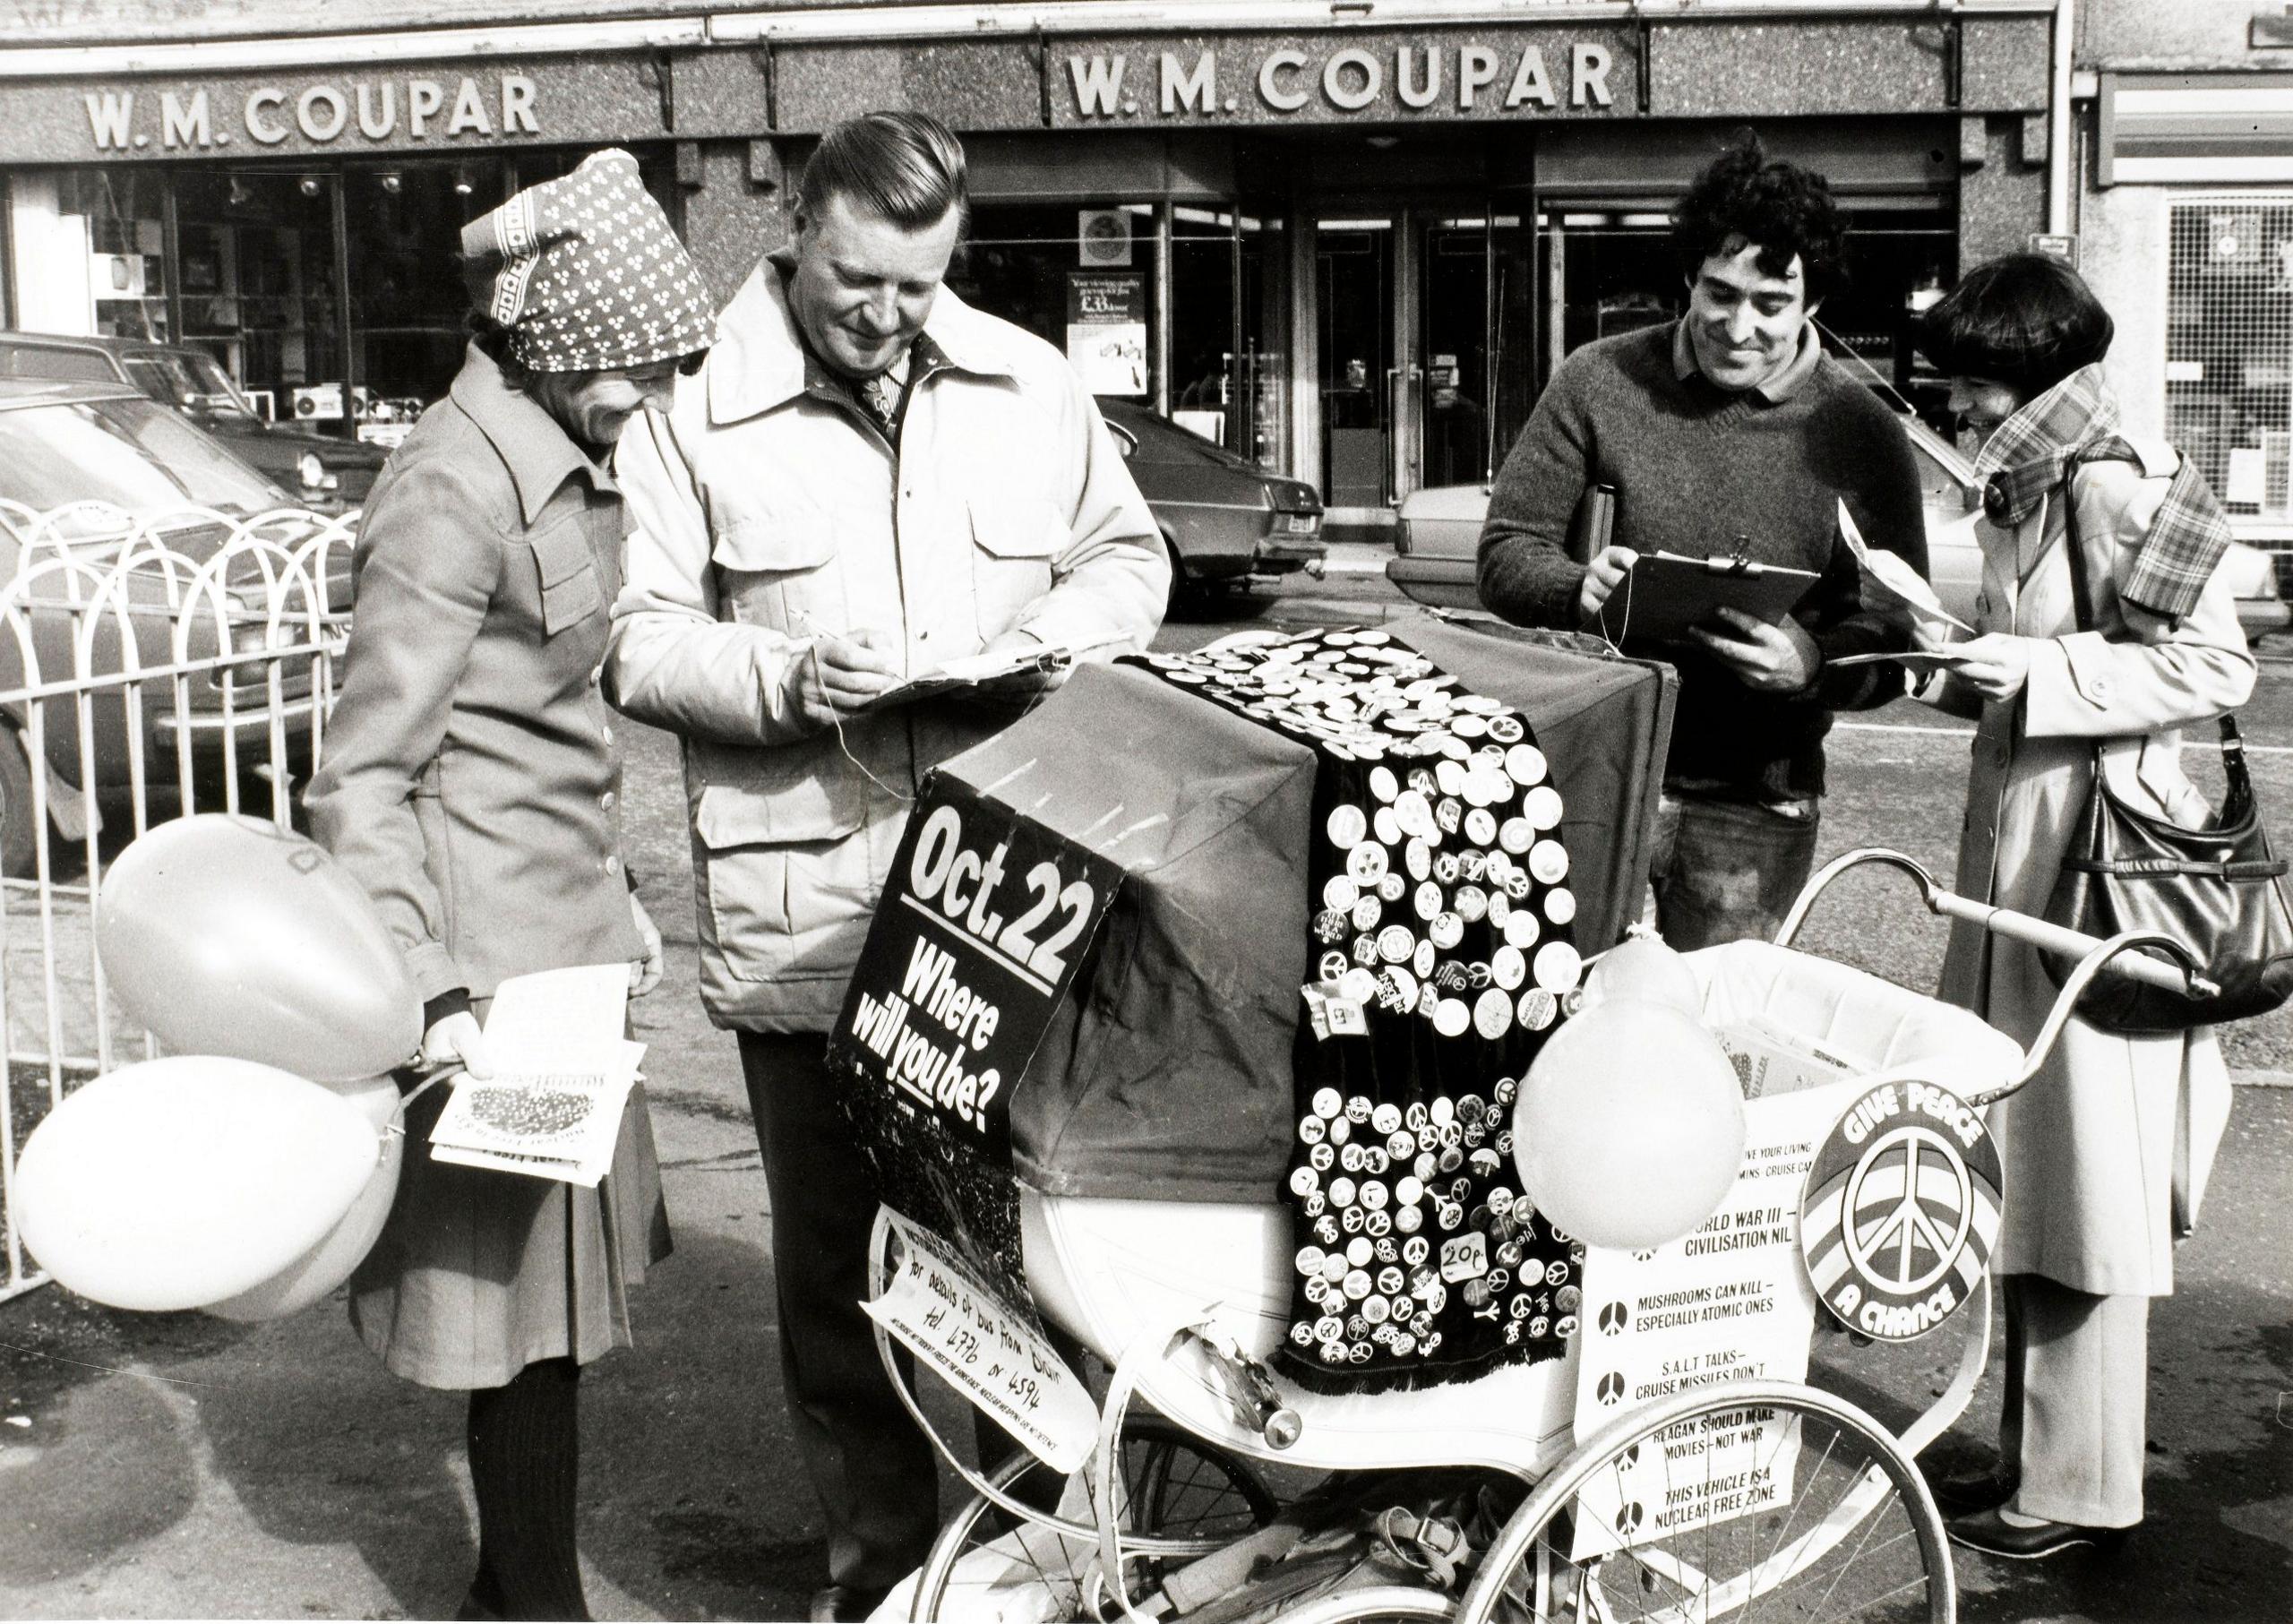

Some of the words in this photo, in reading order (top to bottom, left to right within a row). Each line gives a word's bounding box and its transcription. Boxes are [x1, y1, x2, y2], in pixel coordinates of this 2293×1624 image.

[1258, 42, 1613, 111] COUPAR
[245, 76, 540, 144] COUPAR
[901, 934, 1000, 1052] Where
[852, 992, 910, 1060] will
[887, 1024, 947, 1092] you
[936, 1044, 1001, 1133] be?
[1842, 1085, 1900, 1145] GIVE
[1907, 1081, 1985, 1149] PEACE
[1760, 1146, 1782, 1158] YOUR
[1784, 1142, 1811, 1155] LIVING
[1765, 1164, 1796, 1177] CRUISE
[1736, 1209, 1764, 1228] WAR
[1685, 1230, 1767, 1257] CIVILISATION
[1772, 1226, 1792, 1244] NIL
[1636, 1309, 1699, 1332] ESPECIALLY
[1701, 1302, 1742, 1321] ATOMIC
[1746, 1297, 1773, 1315] ONES
[1637, 1286, 1712, 1311] MUSHROOMS
[1714, 1284, 1737, 1300] CAN
[1739, 1280, 1762, 1296] KILL
[1834, 1284, 1861, 1317] A
[1859, 1283, 1956, 1336] CHANCE
[962, 1293, 973, 1319] of
[976, 1309, 994, 1336] bus
[999, 1318, 1023, 1355] from
[1008, 1371, 1040, 1412] 4594
[1636, 1379, 1676, 1400] CRUISE
[1732, 1362, 1765, 1379] DON'T
[1700, 1412, 1743, 1434] SHOULD
[1746, 1407, 1775, 1424] MAKE
[1740, 1427, 1764, 1444] WAR
[1655, 1501, 1709, 1530] NUCLEAR
[1713, 1493, 1742, 1515] FREE
[1747, 1484, 1776, 1506] ZONE
[1665, 1485, 1693, 1506] THIS
[1696, 1472, 1748, 1498] VEHICLE
